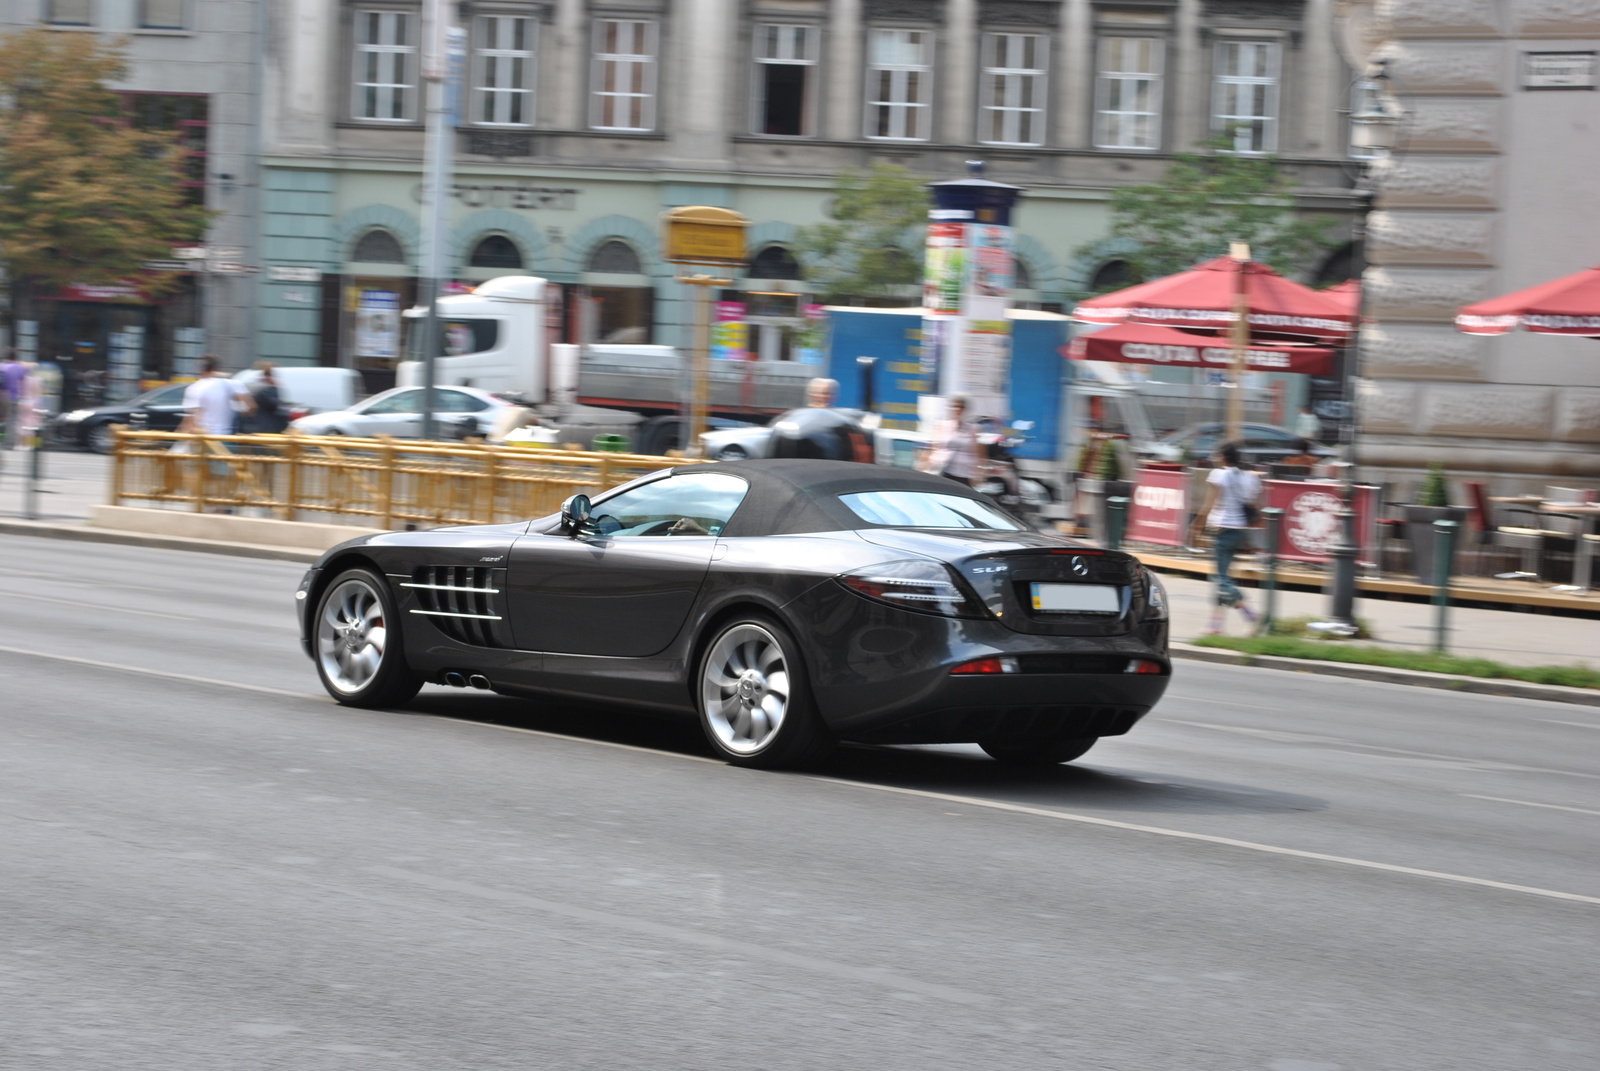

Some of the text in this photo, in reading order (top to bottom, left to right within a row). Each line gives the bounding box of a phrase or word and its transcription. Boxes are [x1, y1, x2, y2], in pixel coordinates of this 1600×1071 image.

[1121, 342, 1290, 368] COSTA COFEE
[972, 565, 1009, 574] SLR
